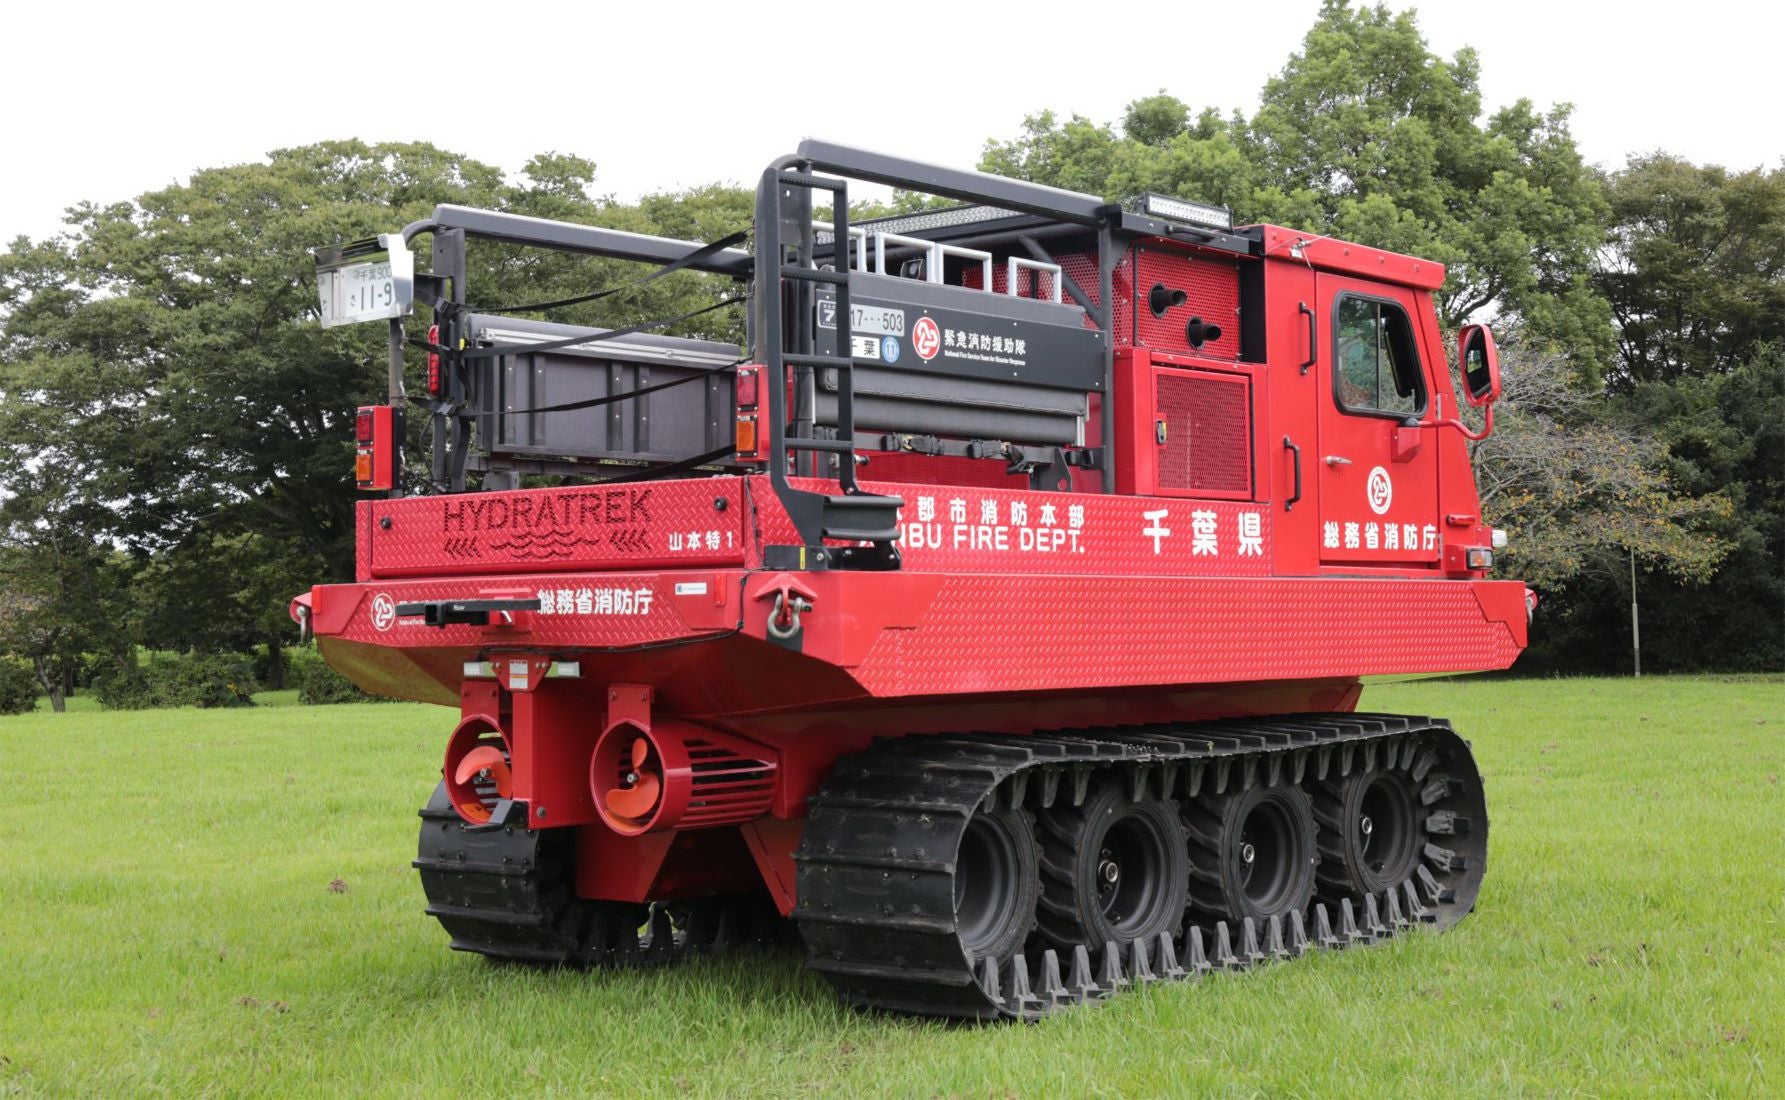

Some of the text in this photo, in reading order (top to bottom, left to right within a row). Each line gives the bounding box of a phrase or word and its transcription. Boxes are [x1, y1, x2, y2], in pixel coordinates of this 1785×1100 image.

[361, 282, 392, 311] 11-9
[823, 309, 836, 322] 7
[944, 328, 1026, 355] 緊急消防援助隊
[443, 490, 652, 532] HYDRATREK
[888, 494, 1084, 529] 郡市消防本部
[669, 531, 734, 551] 山本特1
[953, 525, 1009, 550] FIRE
[1020, 528, 1085, 553] DEPT.
[1143, 509, 1263, 556] 千葉県
[1323, 520, 1437, 551] 総務省消防庁
[537, 588, 654, 615] 総務省消防庁
